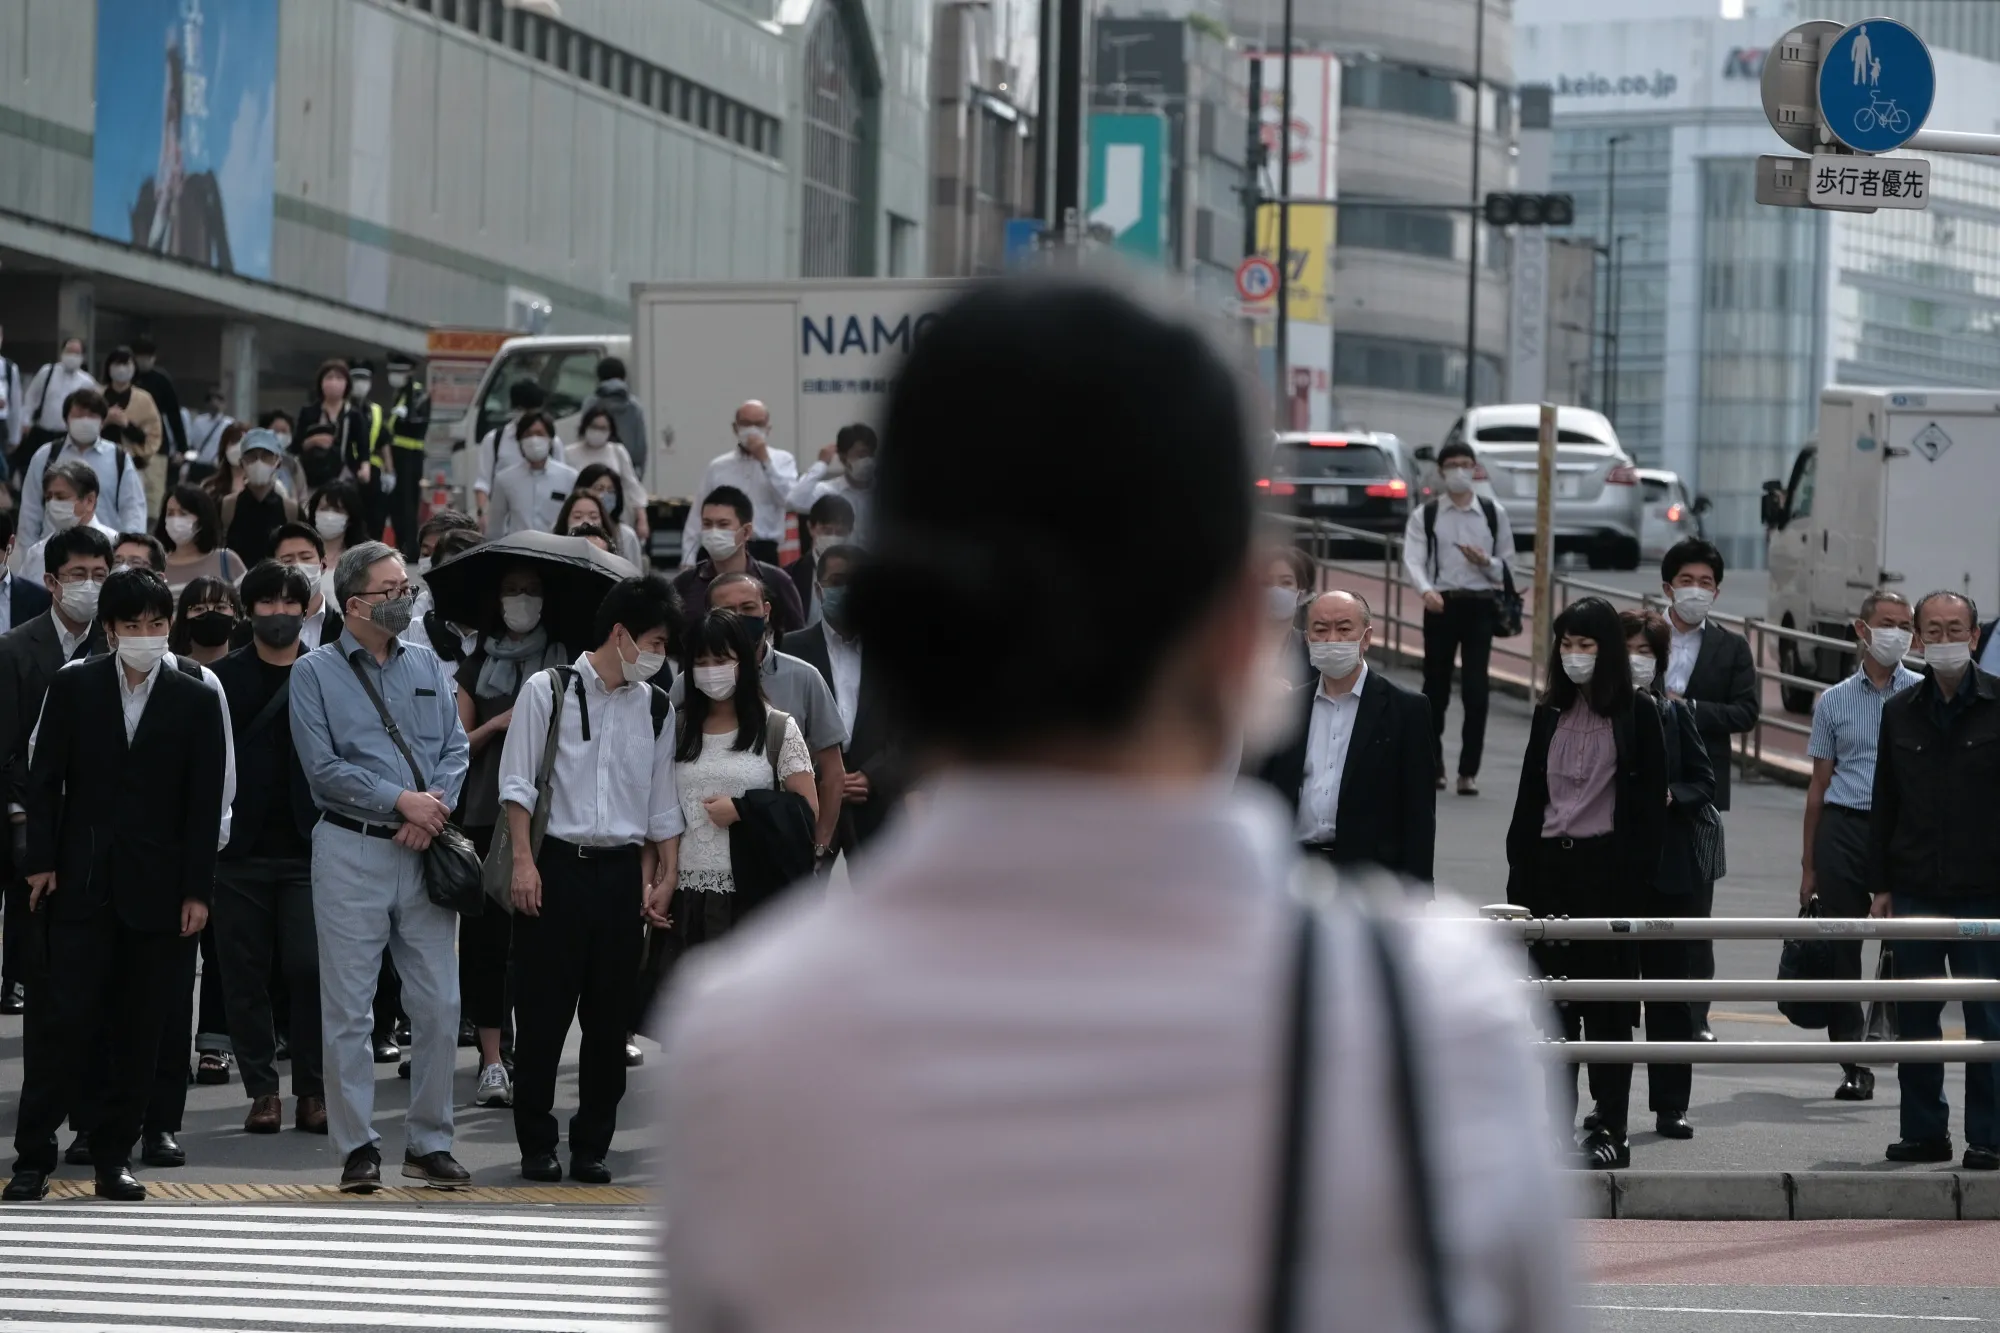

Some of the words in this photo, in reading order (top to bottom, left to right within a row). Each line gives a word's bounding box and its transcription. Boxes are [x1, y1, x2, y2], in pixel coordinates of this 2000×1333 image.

[1816, 166, 1924, 198] 歩行者優先
